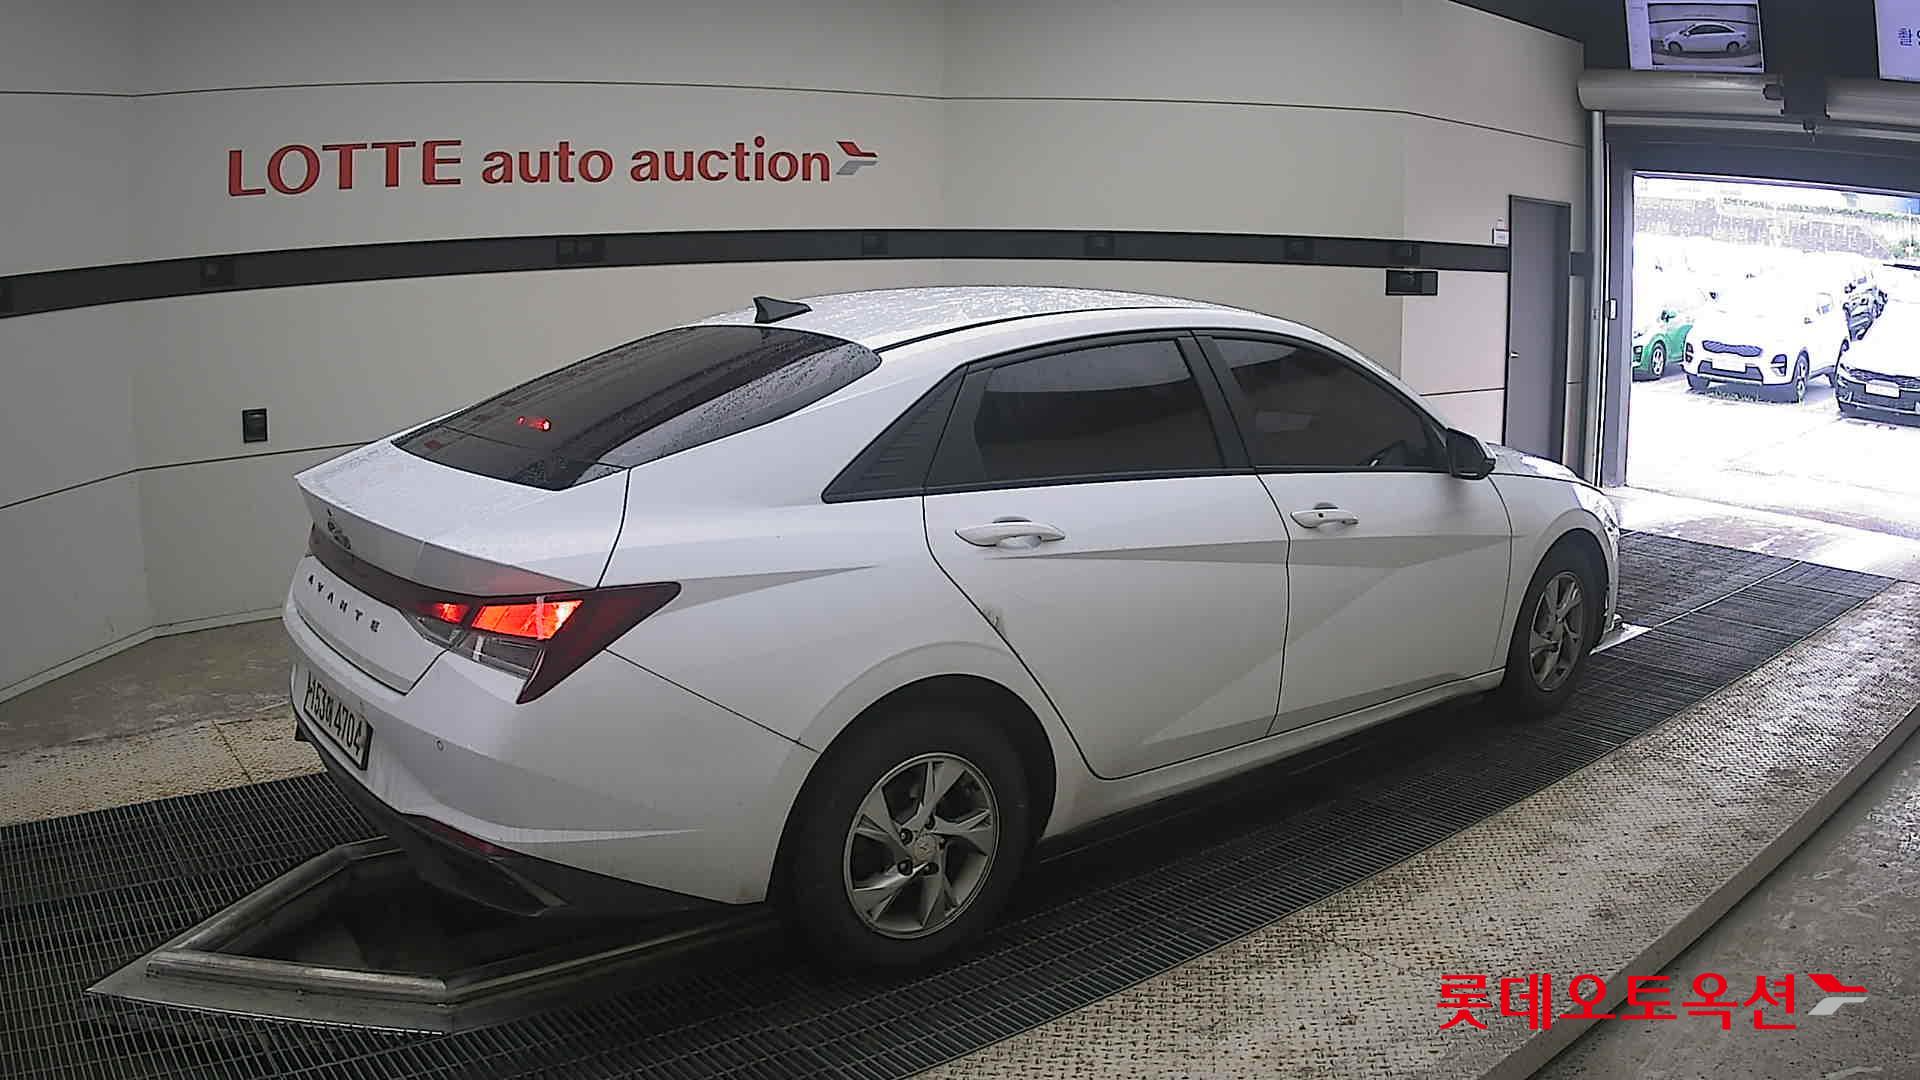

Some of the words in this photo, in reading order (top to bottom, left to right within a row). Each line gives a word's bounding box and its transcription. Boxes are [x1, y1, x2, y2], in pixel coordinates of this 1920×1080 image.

[228, 139, 462, 197] LOTTE
[481, 141, 613, 184] auto
[630, 136, 831, 182] auction
[308, 574, 381, 633] AVANTE
[334, 702, 363, 756] 4704
